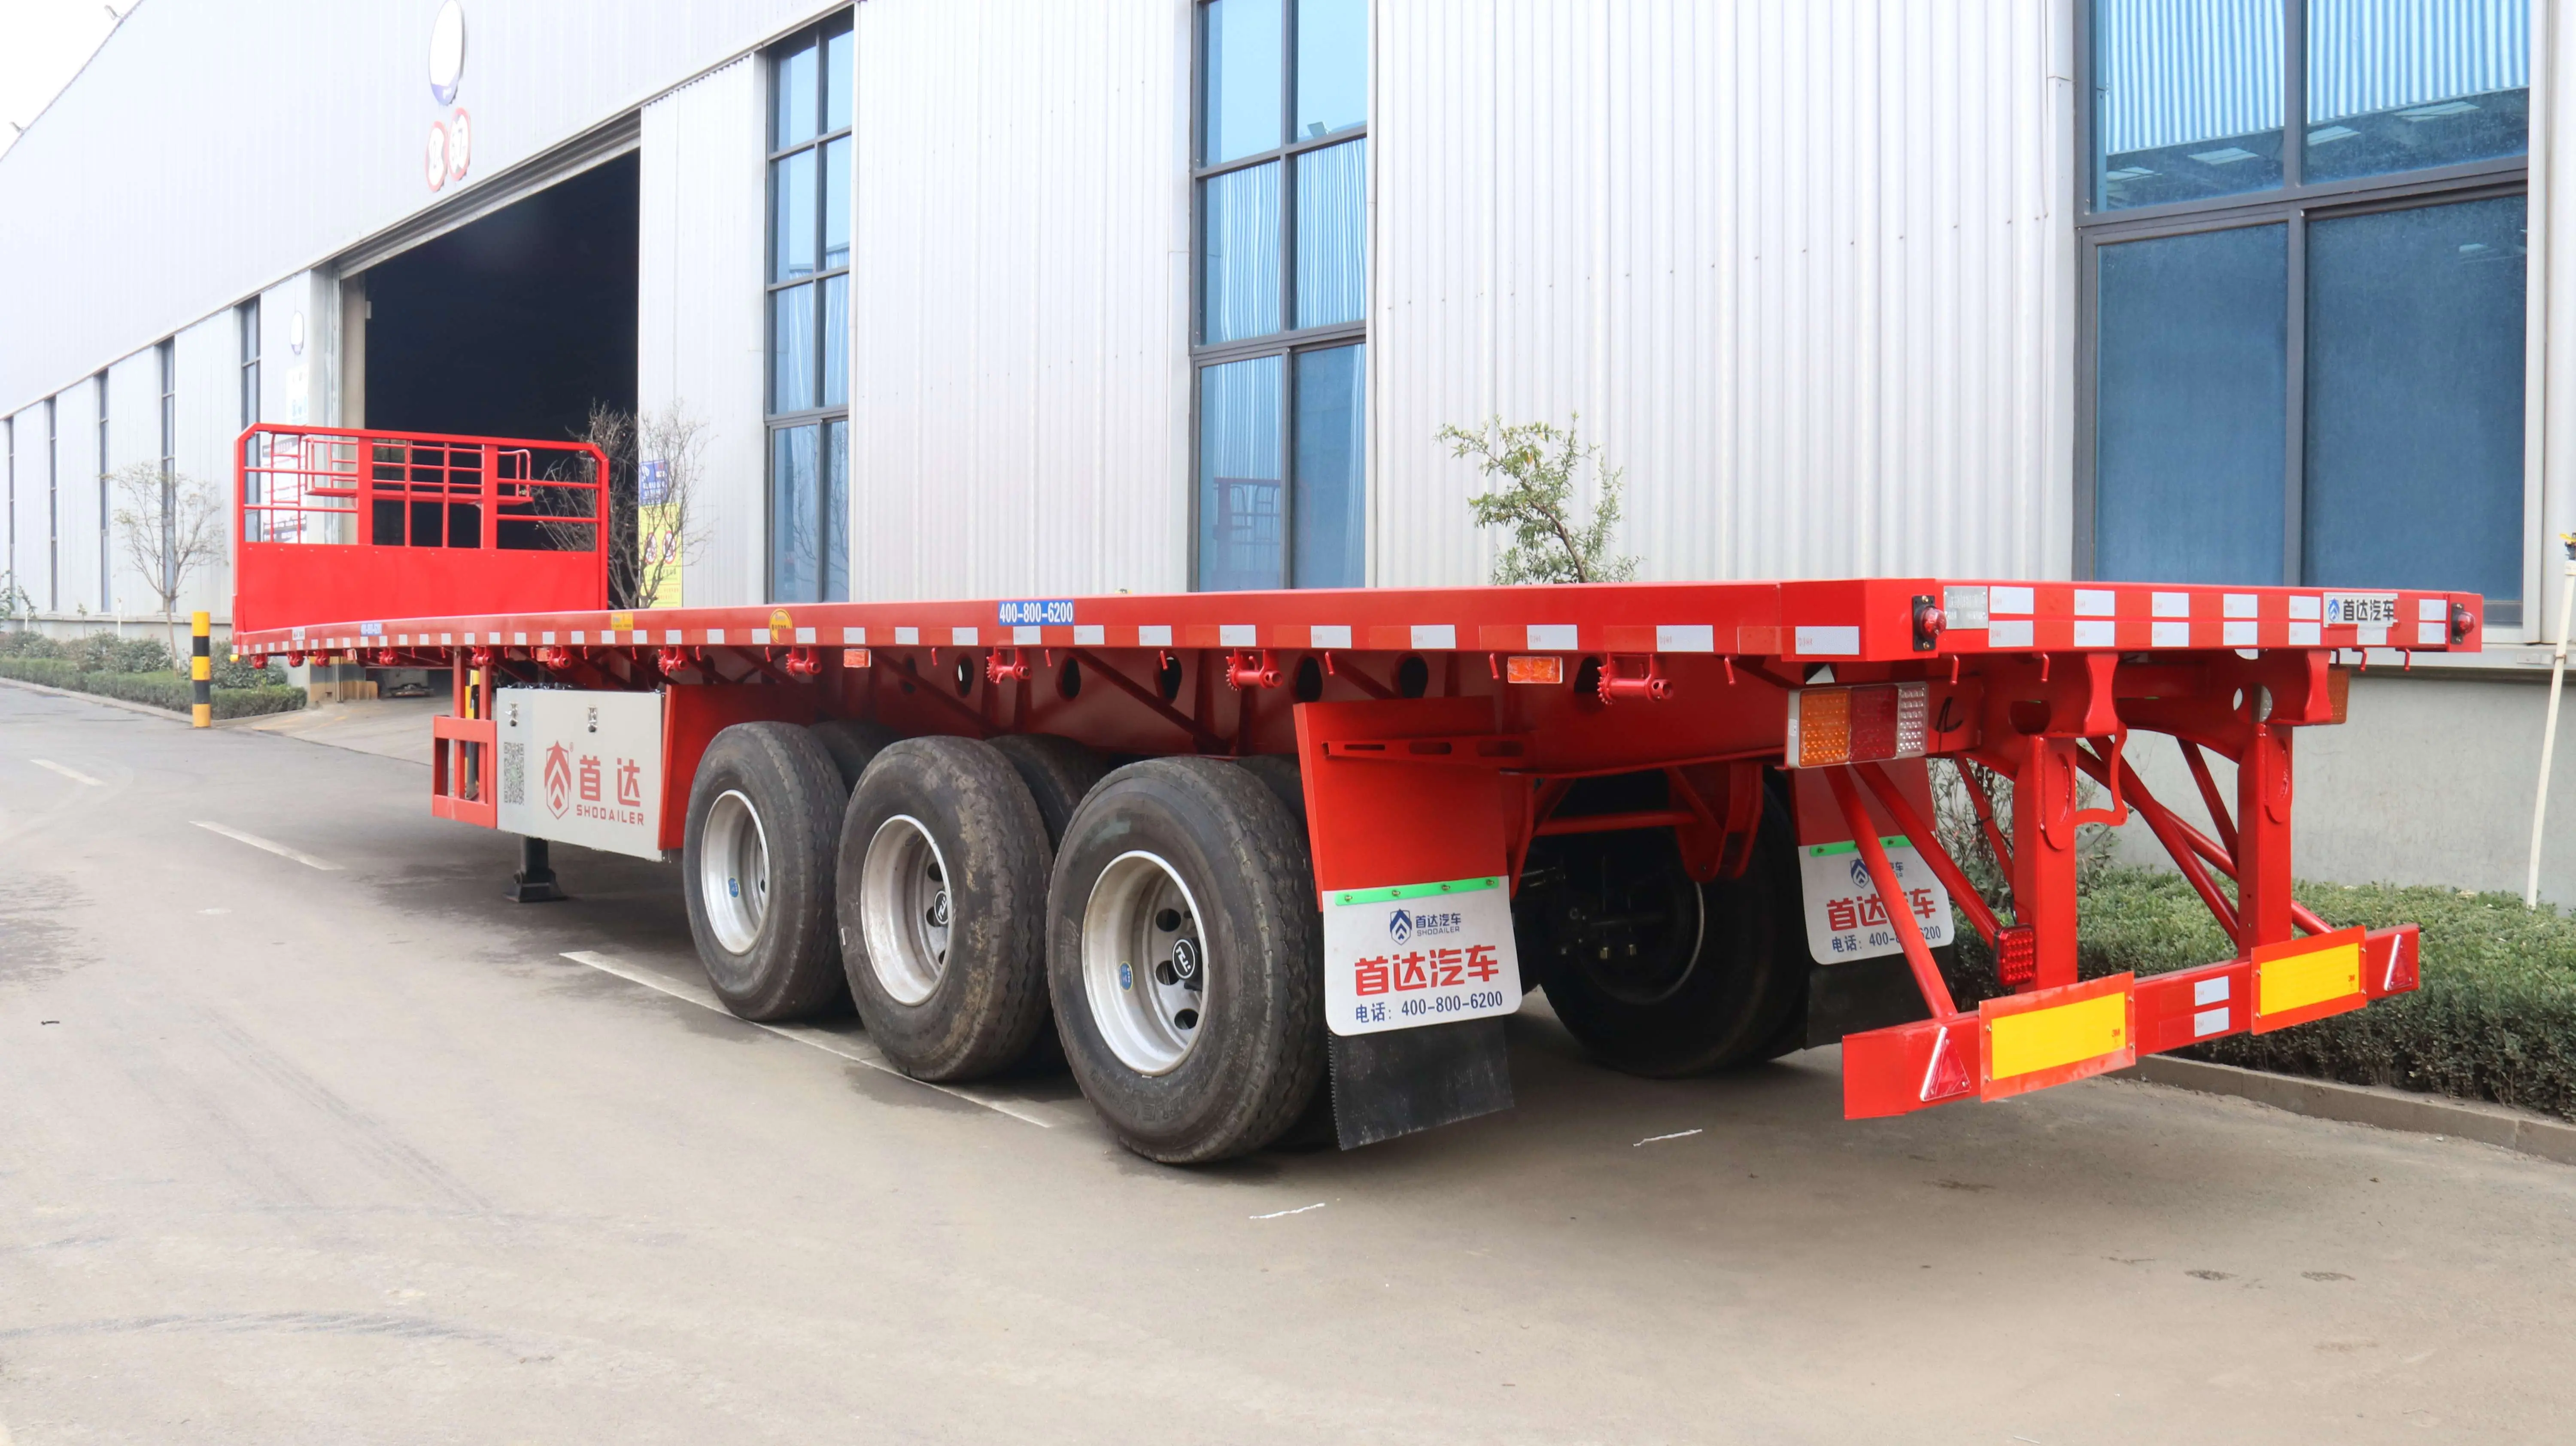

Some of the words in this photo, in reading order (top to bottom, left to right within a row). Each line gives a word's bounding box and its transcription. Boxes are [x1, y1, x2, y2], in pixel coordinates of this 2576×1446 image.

[999, 601, 1073, 623] 400-800-6200
[2343, 599, 2394, 621] 首达汽车
[580, 755, 641, 807] 首达
[1415, 912, 1461, 929] 首达汽车
[1826, 888, 1936, 932] 首达车
[1354, 945, 1499, 996] 首达汽车
[1401, 992, 1503, 1016] 400-800-6200
